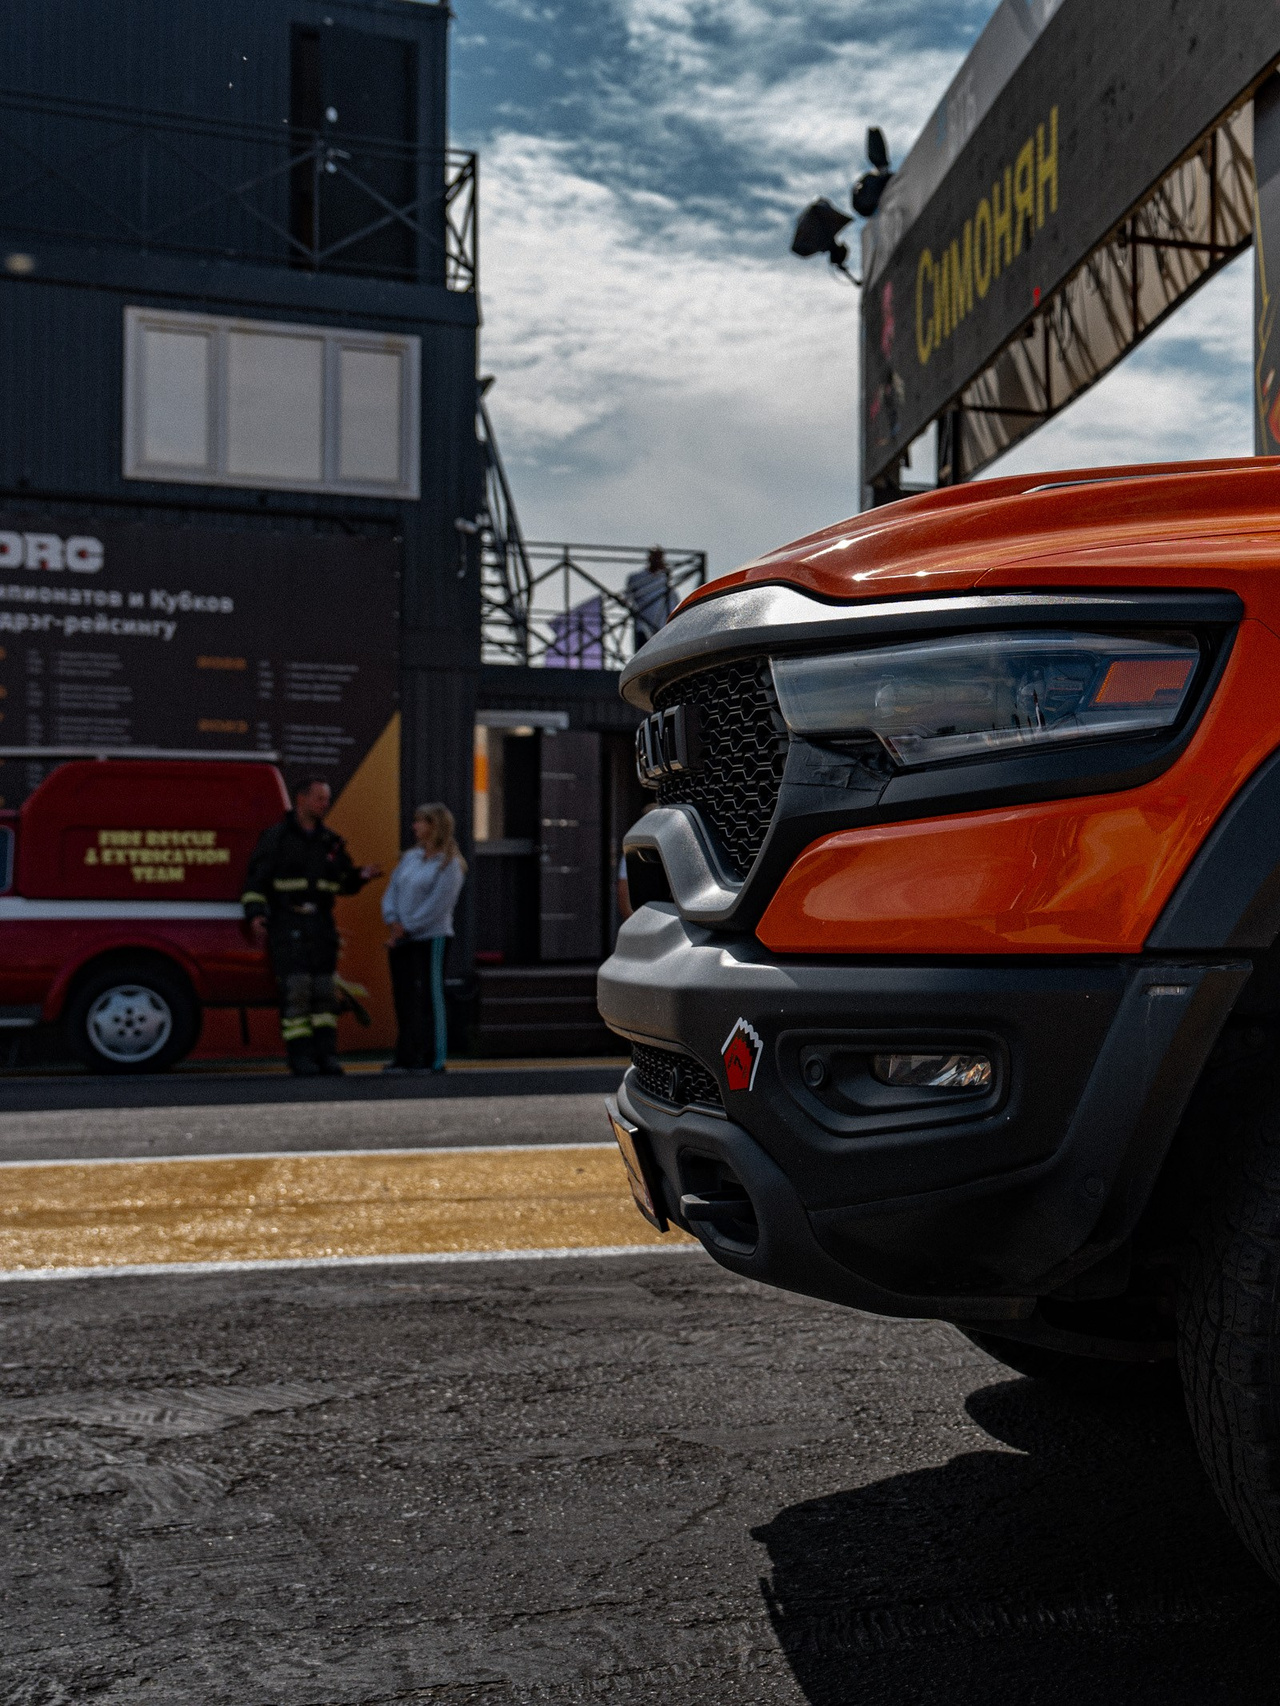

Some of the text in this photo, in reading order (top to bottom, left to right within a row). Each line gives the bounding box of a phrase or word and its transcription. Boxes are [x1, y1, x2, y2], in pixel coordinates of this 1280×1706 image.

[149, 589, 234, 614] Кубков
[98, 830, 217, 847] FIRE RESCUE
[131, 865, 186, 883] TEAM
